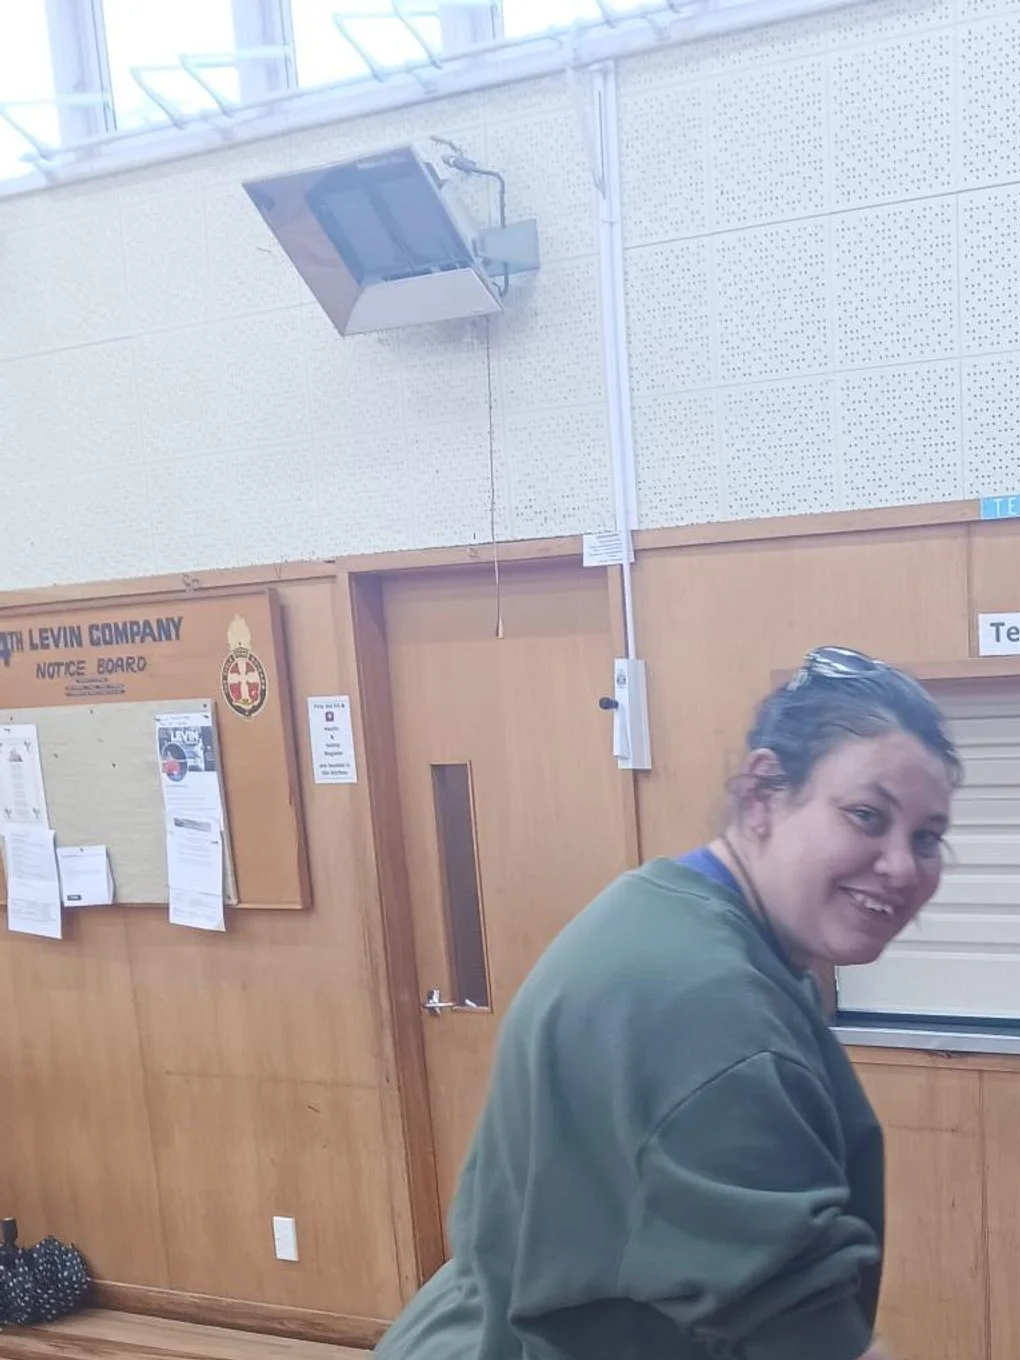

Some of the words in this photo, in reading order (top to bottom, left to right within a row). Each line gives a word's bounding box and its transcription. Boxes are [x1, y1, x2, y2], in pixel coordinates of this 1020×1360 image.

[28, 624, 83, 651] LEVIN
[88, 616, 184, 647] COMPANY
[36, 660, 87, 679] NOTICE
[97, 656, 148, 675] BOARD
